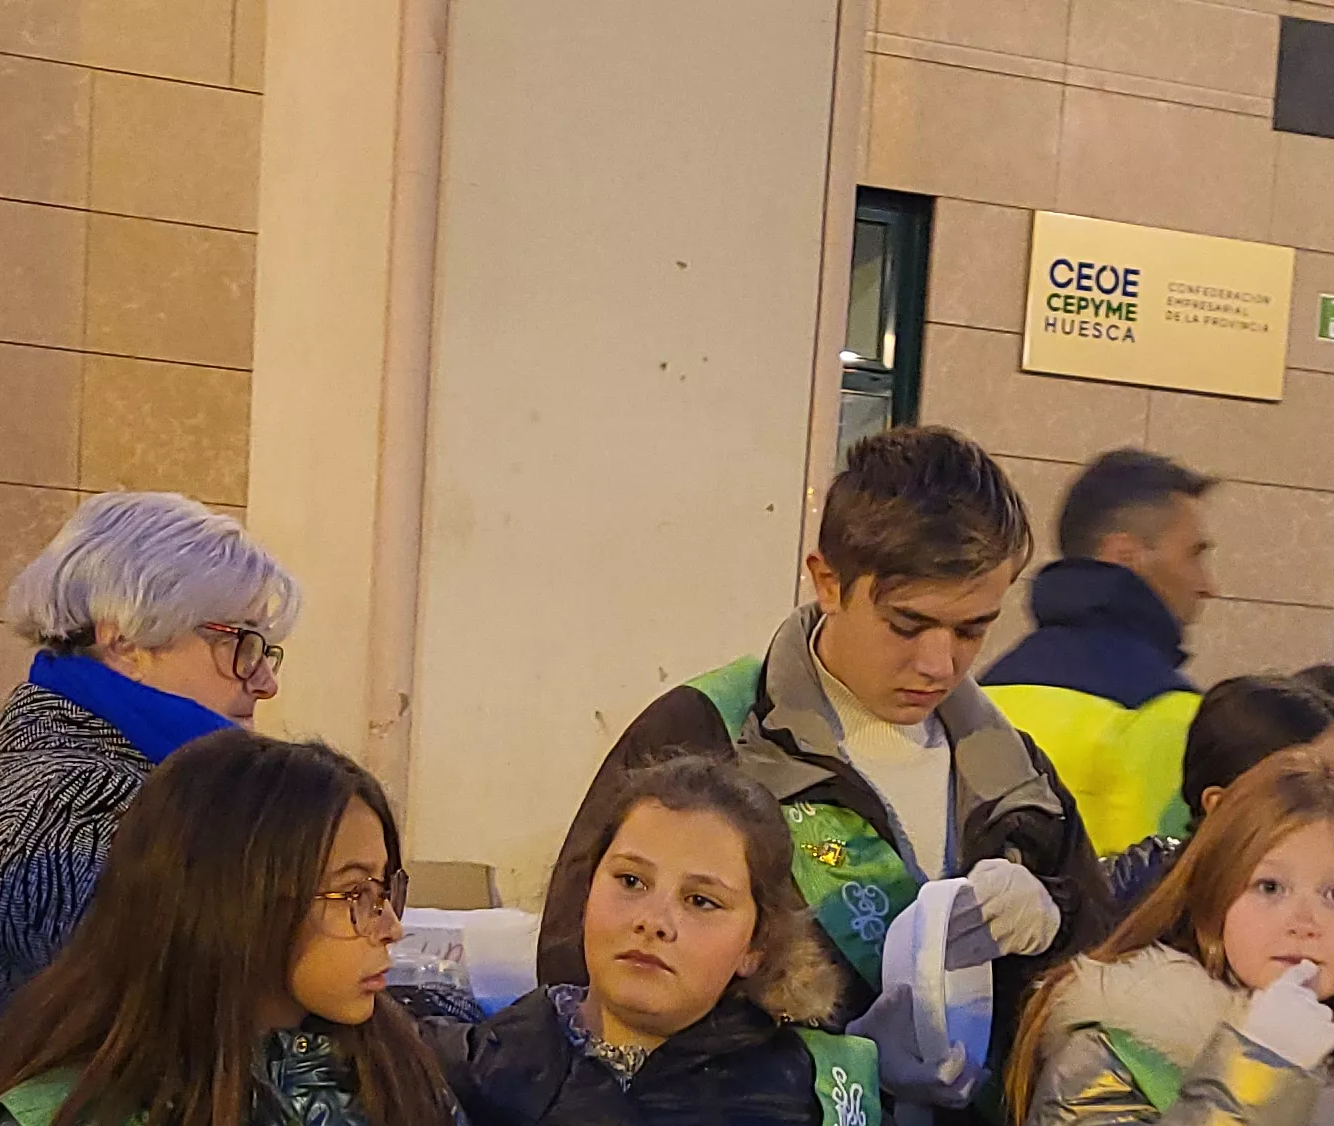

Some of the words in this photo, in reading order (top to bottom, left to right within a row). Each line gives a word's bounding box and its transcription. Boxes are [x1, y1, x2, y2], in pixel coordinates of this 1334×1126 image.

[1049, 258, 1141, 298] CEOE
[1046, 292, 1139, 322] CEPYME
[1163, 308, 1181, 322] DE
[1184, 312, 1200, 324] LA
[1202, 314, 1269, 333] PROVINCIA
[1043, 315, 1136, 344] HUESCA
